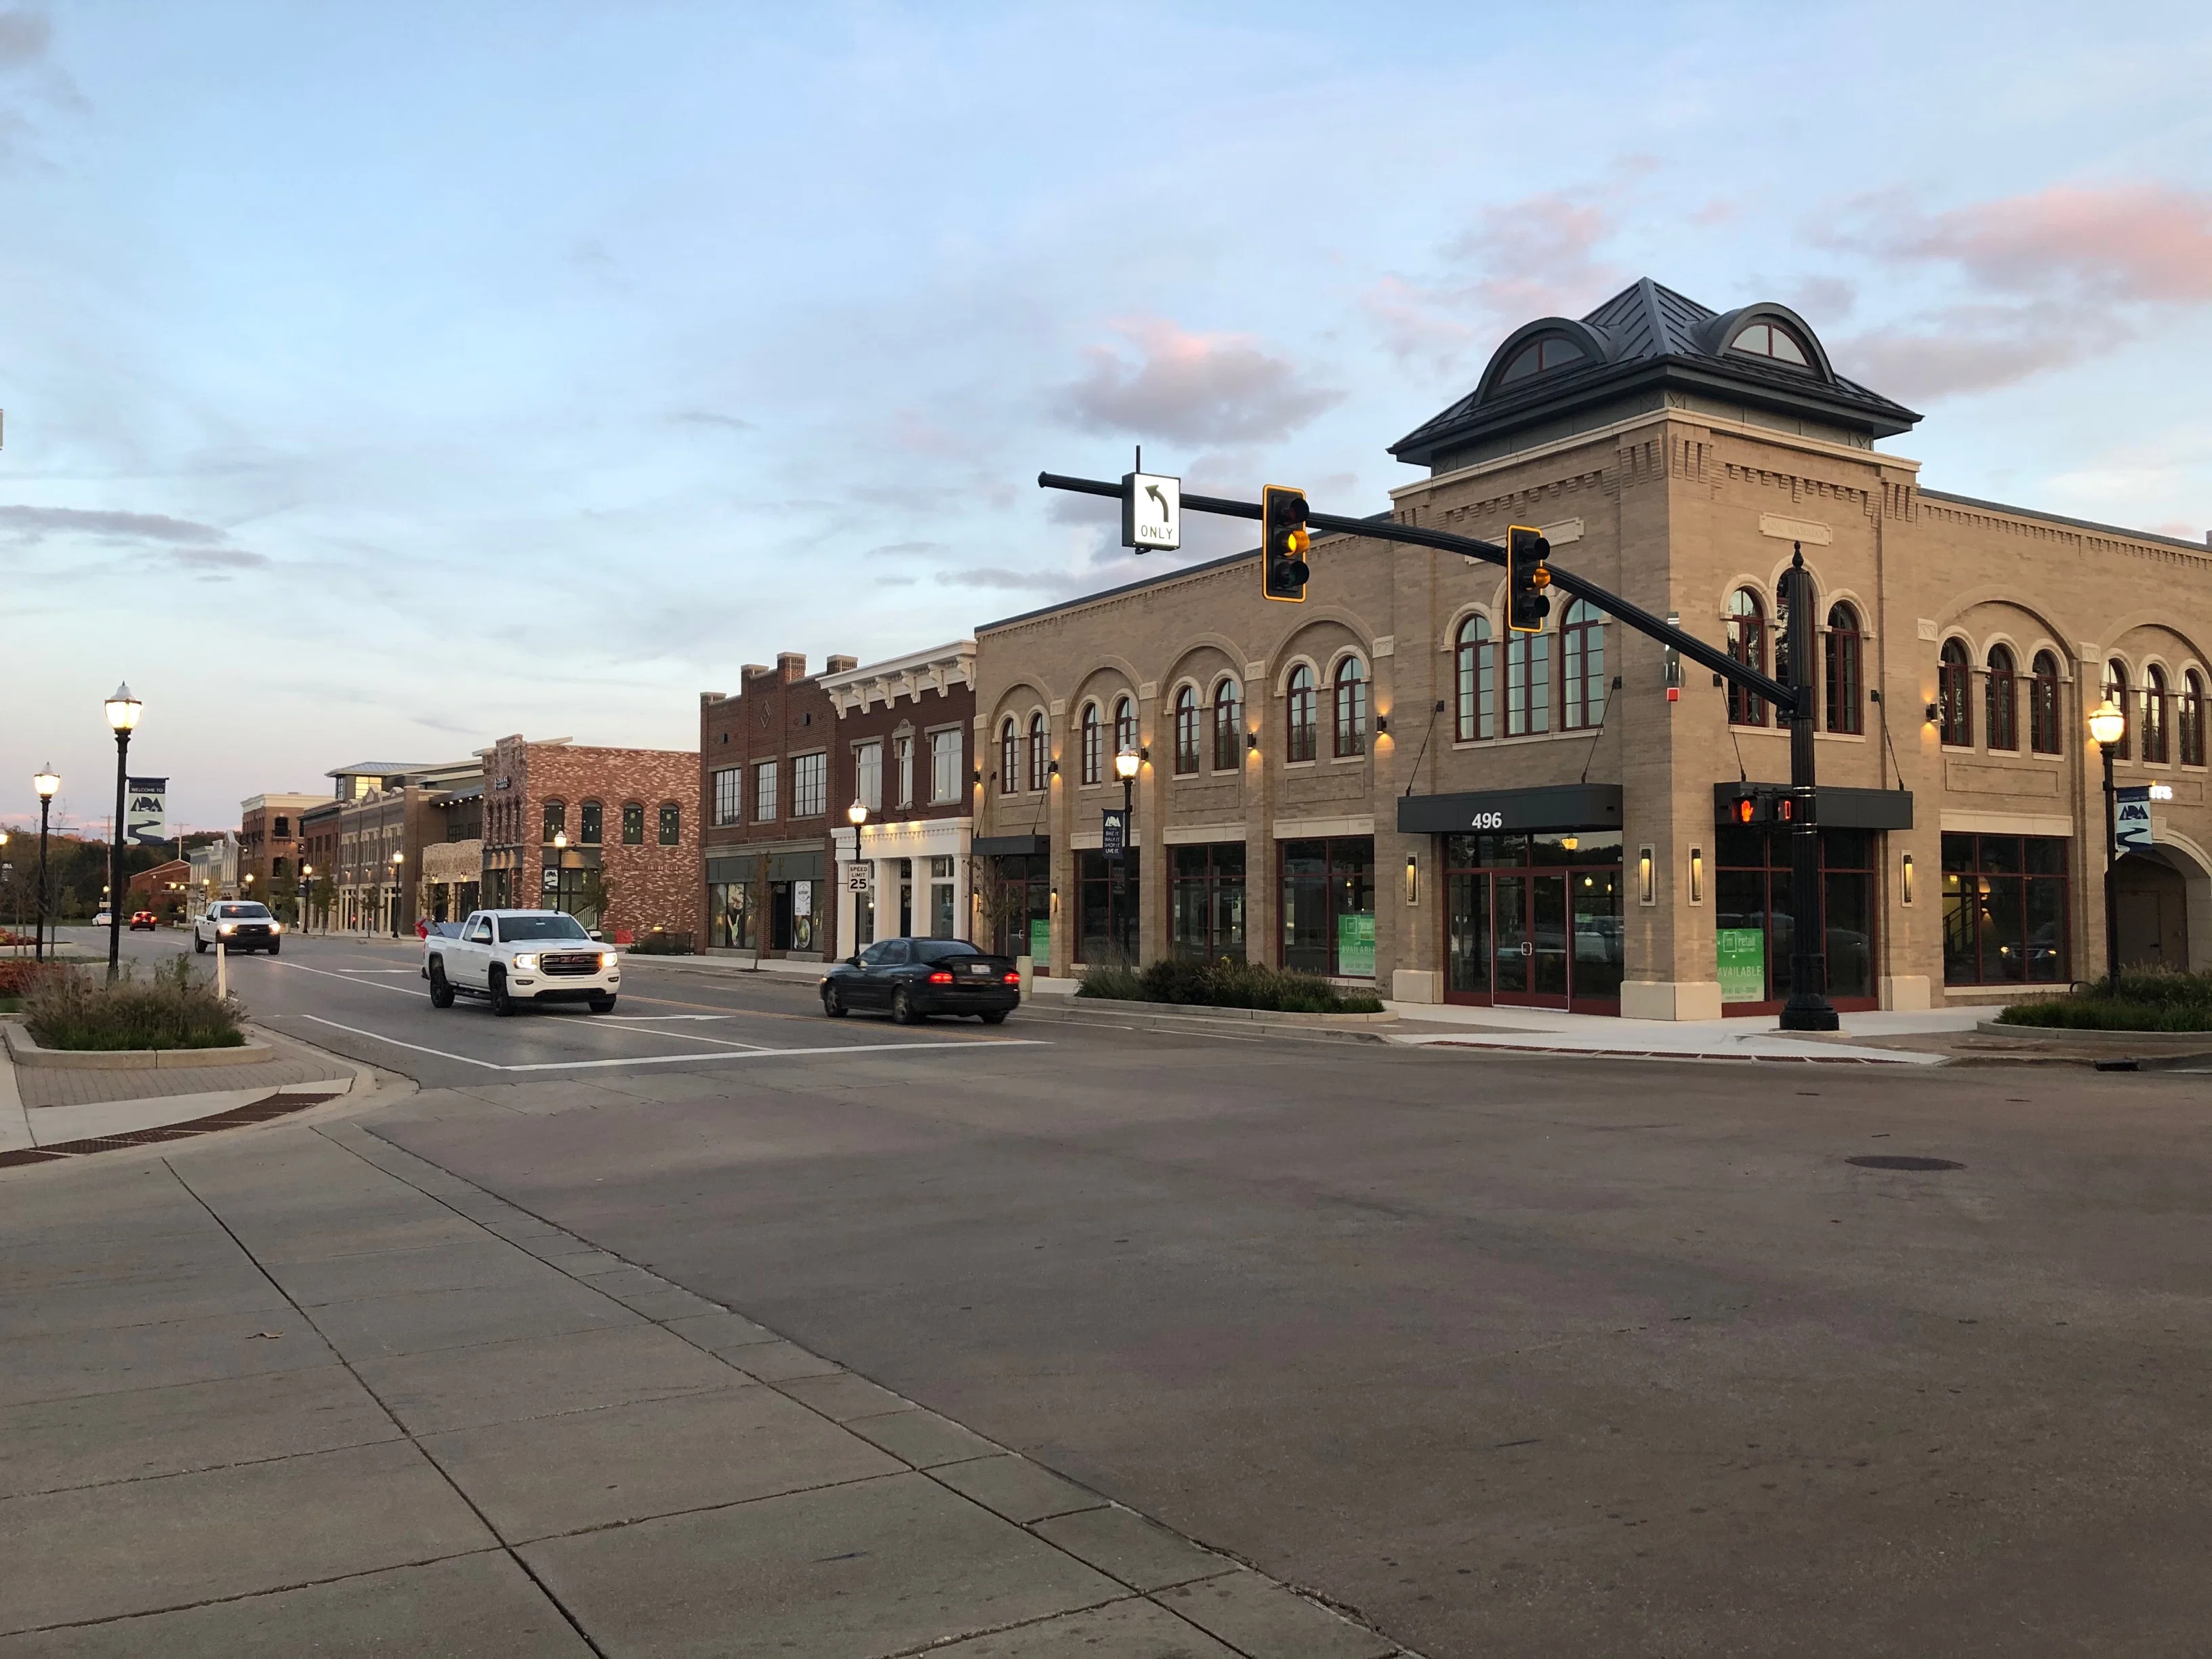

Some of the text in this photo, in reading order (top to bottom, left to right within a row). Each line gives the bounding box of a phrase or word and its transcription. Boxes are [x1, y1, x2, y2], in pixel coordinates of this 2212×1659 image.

[1141, 525, 1173, 540] ONLY
[130, 796, 163, 812] ADA
[2118, 804, 2149, 821] ADA
[1471, 812, 1502, 829] 496
[850, 878, 867, 889] 25
[1738, 936, 1756, 946] retail
[1717, 966, 1762, 977] AVAILABLE
